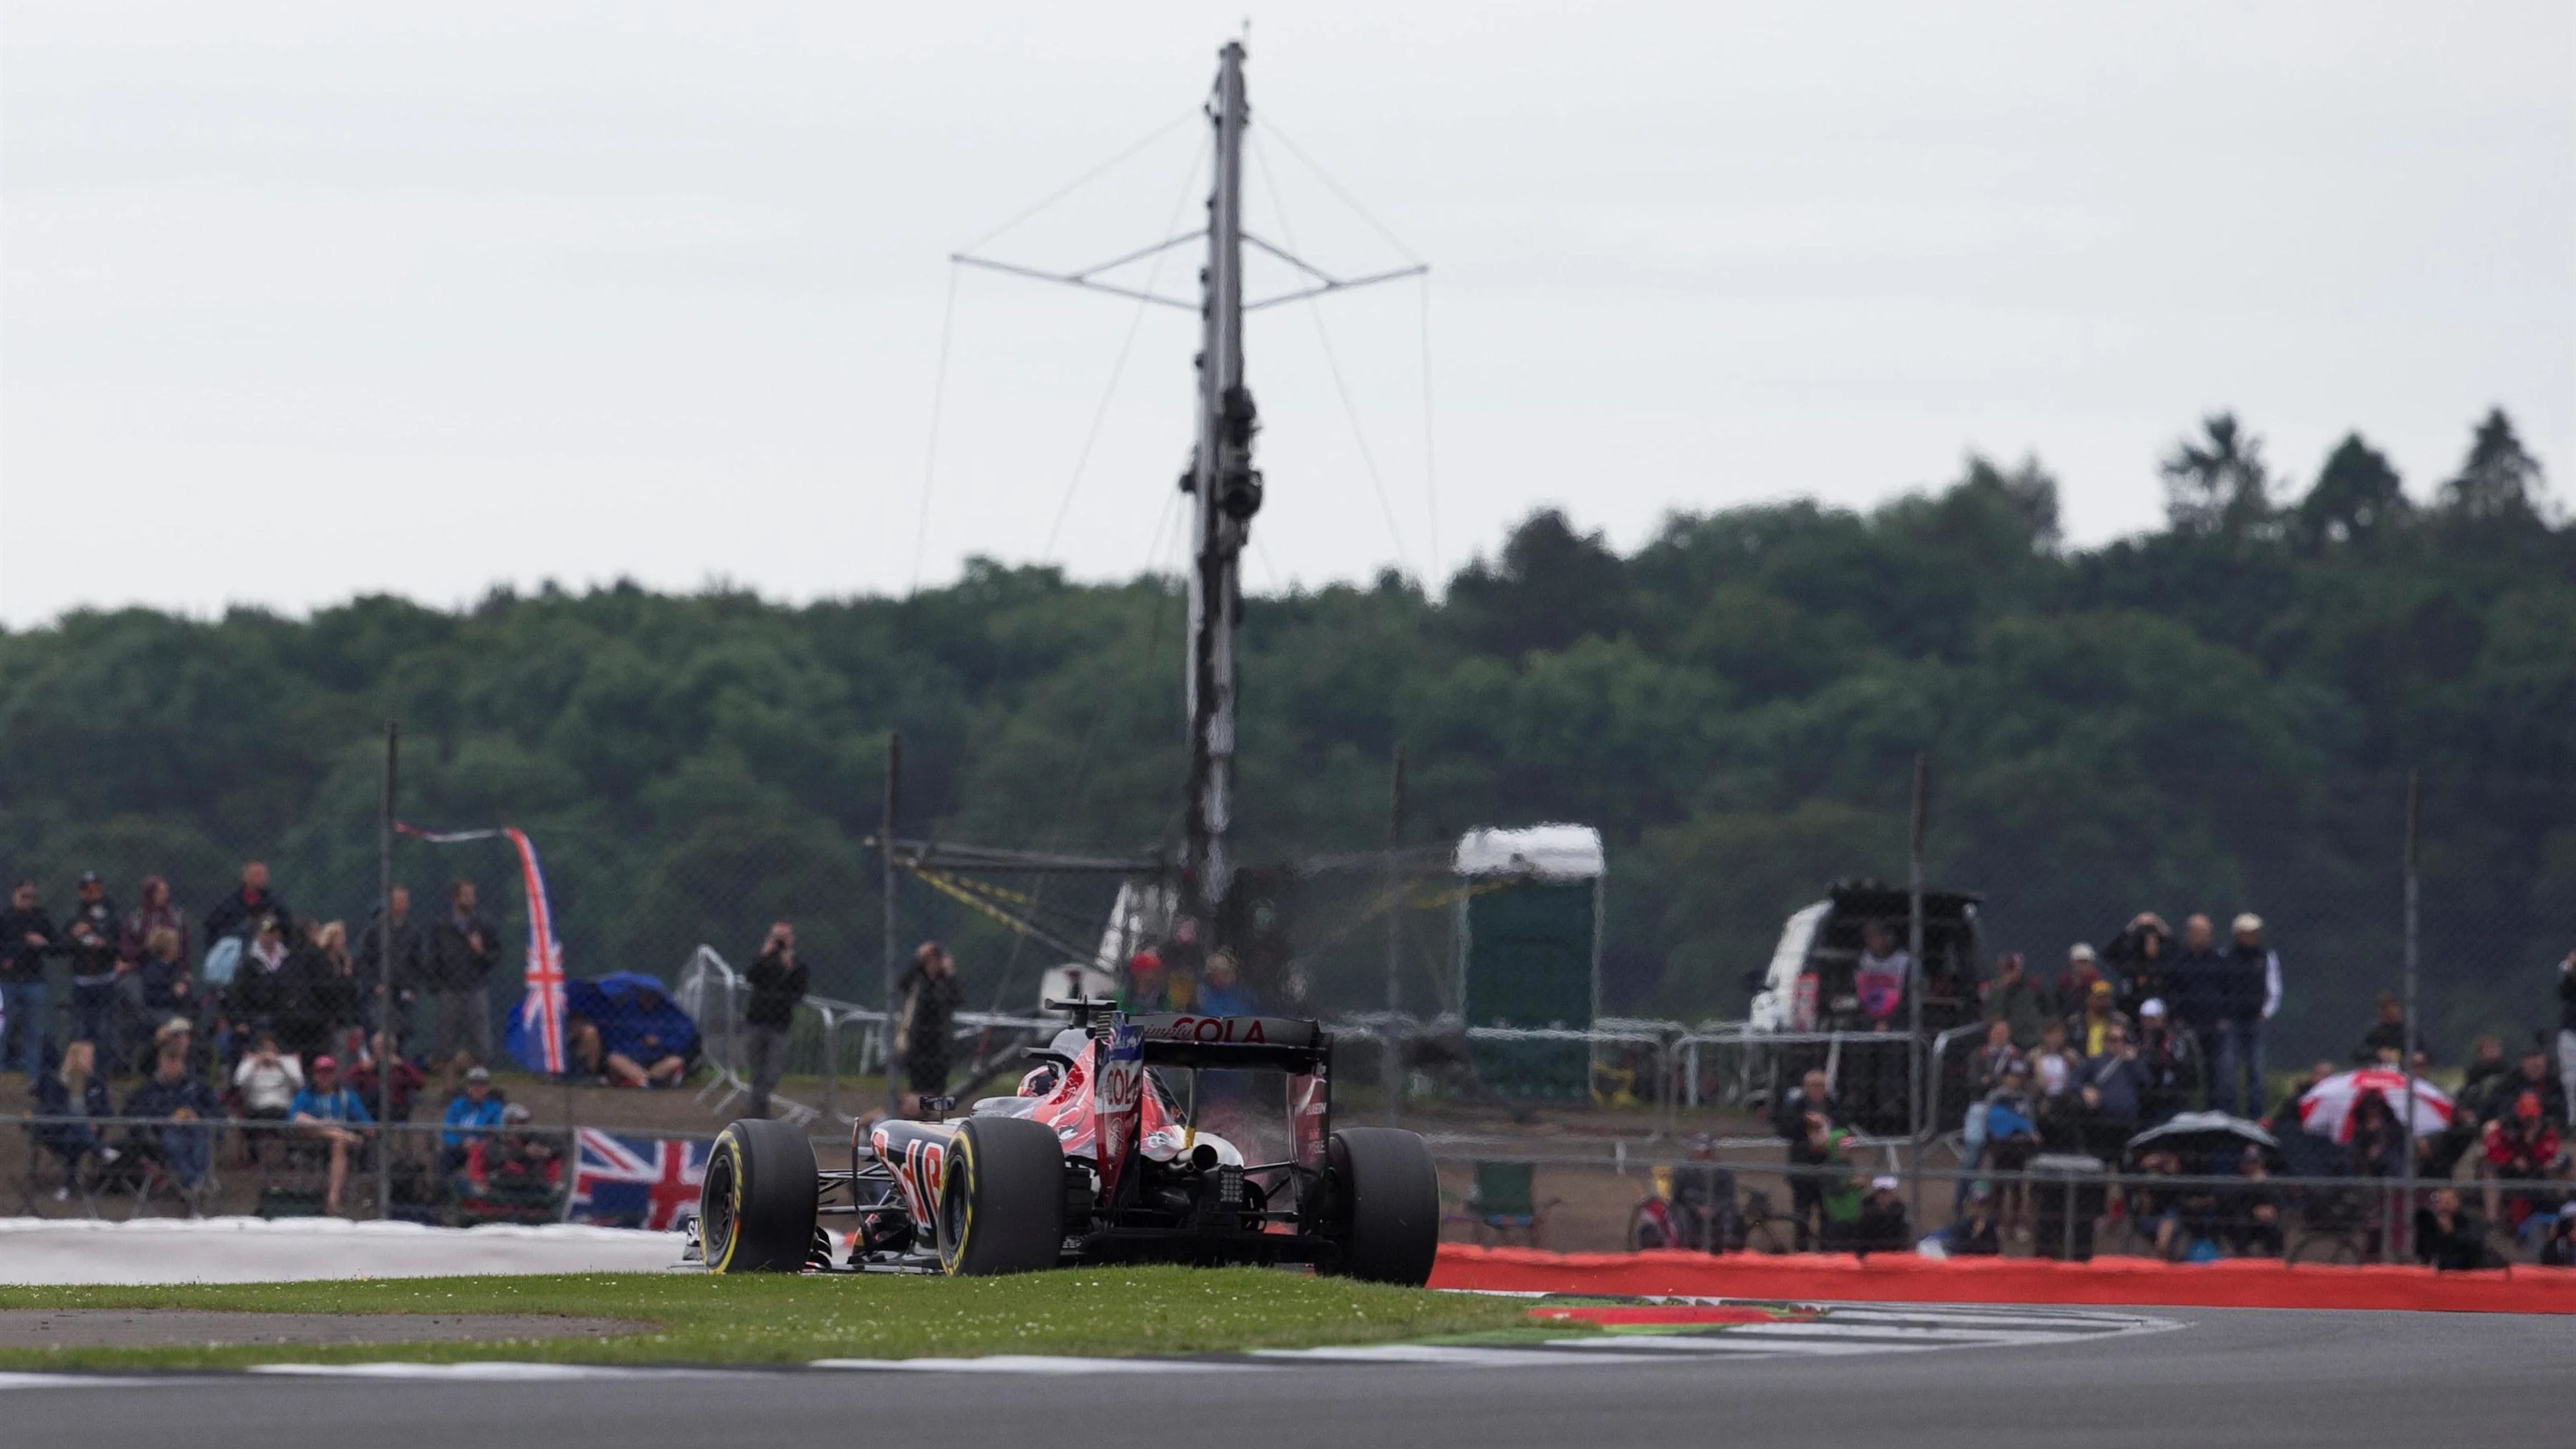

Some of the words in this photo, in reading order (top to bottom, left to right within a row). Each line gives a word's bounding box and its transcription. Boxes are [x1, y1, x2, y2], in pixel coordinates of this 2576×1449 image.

[1145, 1024, 1193, 1039] imply
[1173, 1017, 1266, 1044] COLA
[687, 1220, 700, 1245] SA
